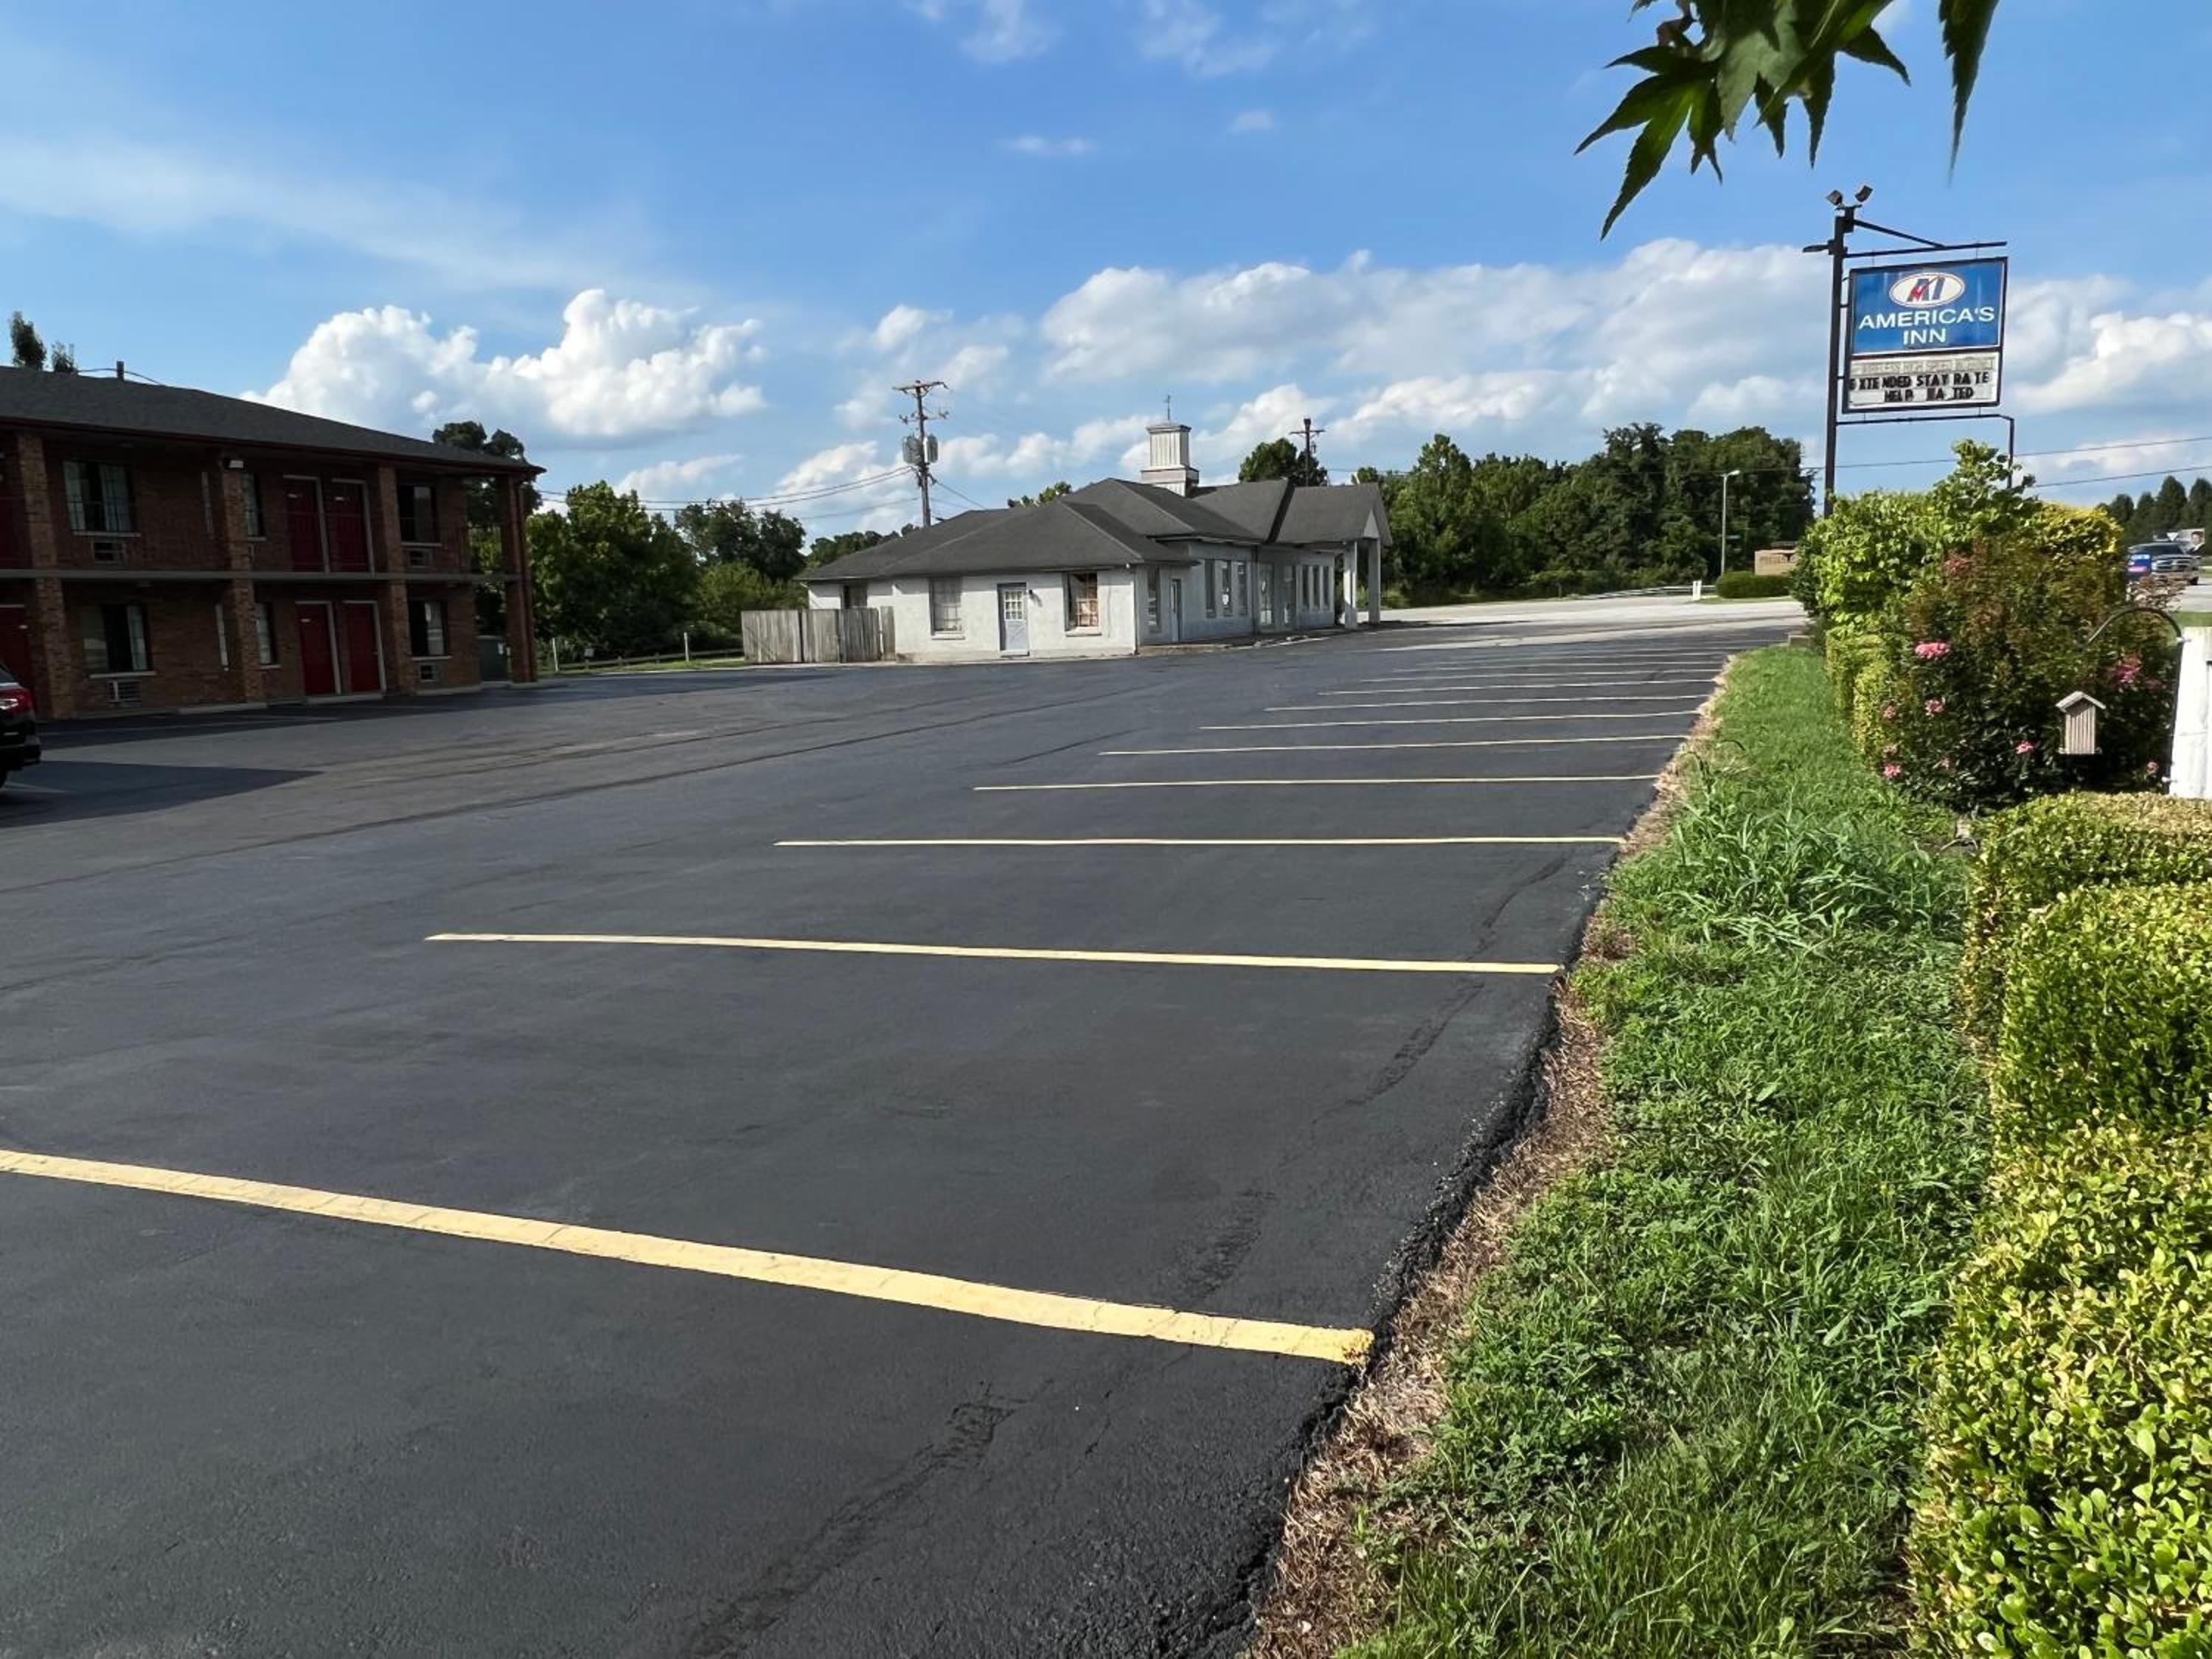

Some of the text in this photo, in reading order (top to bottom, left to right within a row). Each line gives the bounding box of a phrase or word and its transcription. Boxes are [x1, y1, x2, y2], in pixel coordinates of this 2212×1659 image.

[1859, 306, 1994, 330] AMERICA'S
[1903, 328, 1947, 345] INN
[1916, 373, 1948, 387] STAY
[1884, 389, 1913, 403] HELP
